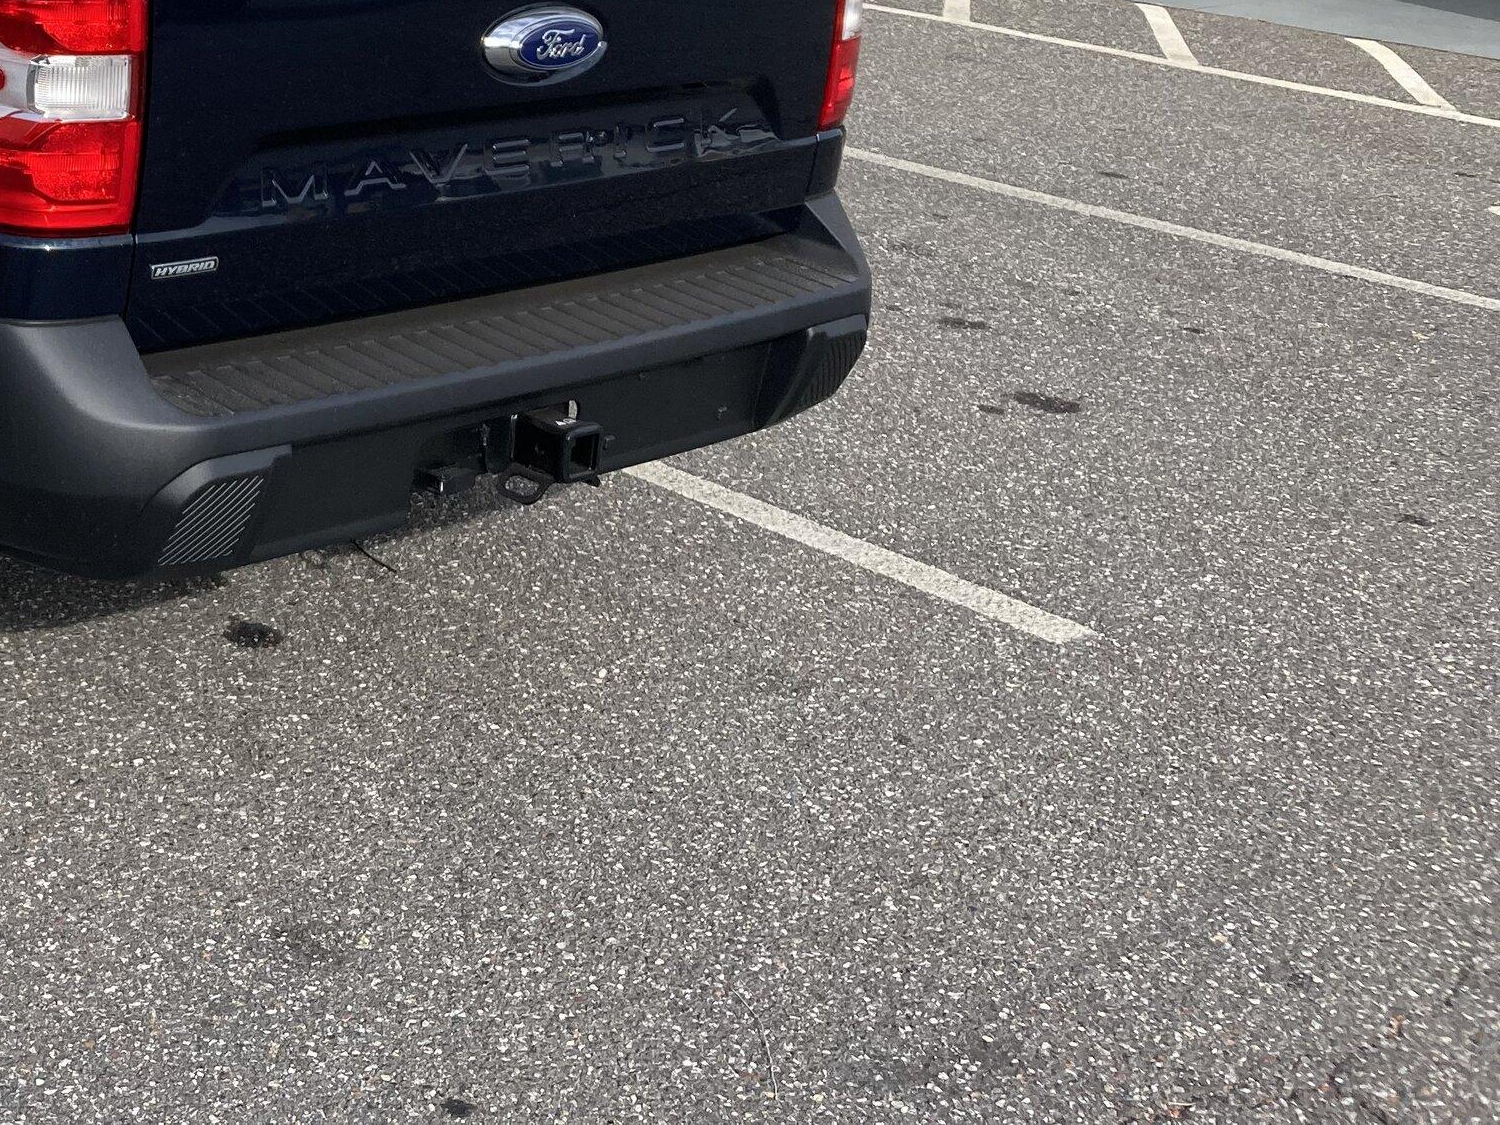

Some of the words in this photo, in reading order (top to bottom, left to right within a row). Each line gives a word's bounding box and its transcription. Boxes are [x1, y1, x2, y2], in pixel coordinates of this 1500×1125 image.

[536, 28, 587, 61] Ford
[261, 108, 740, 207] MAVERICK
[154, 260, 215, 277] HYBRID
